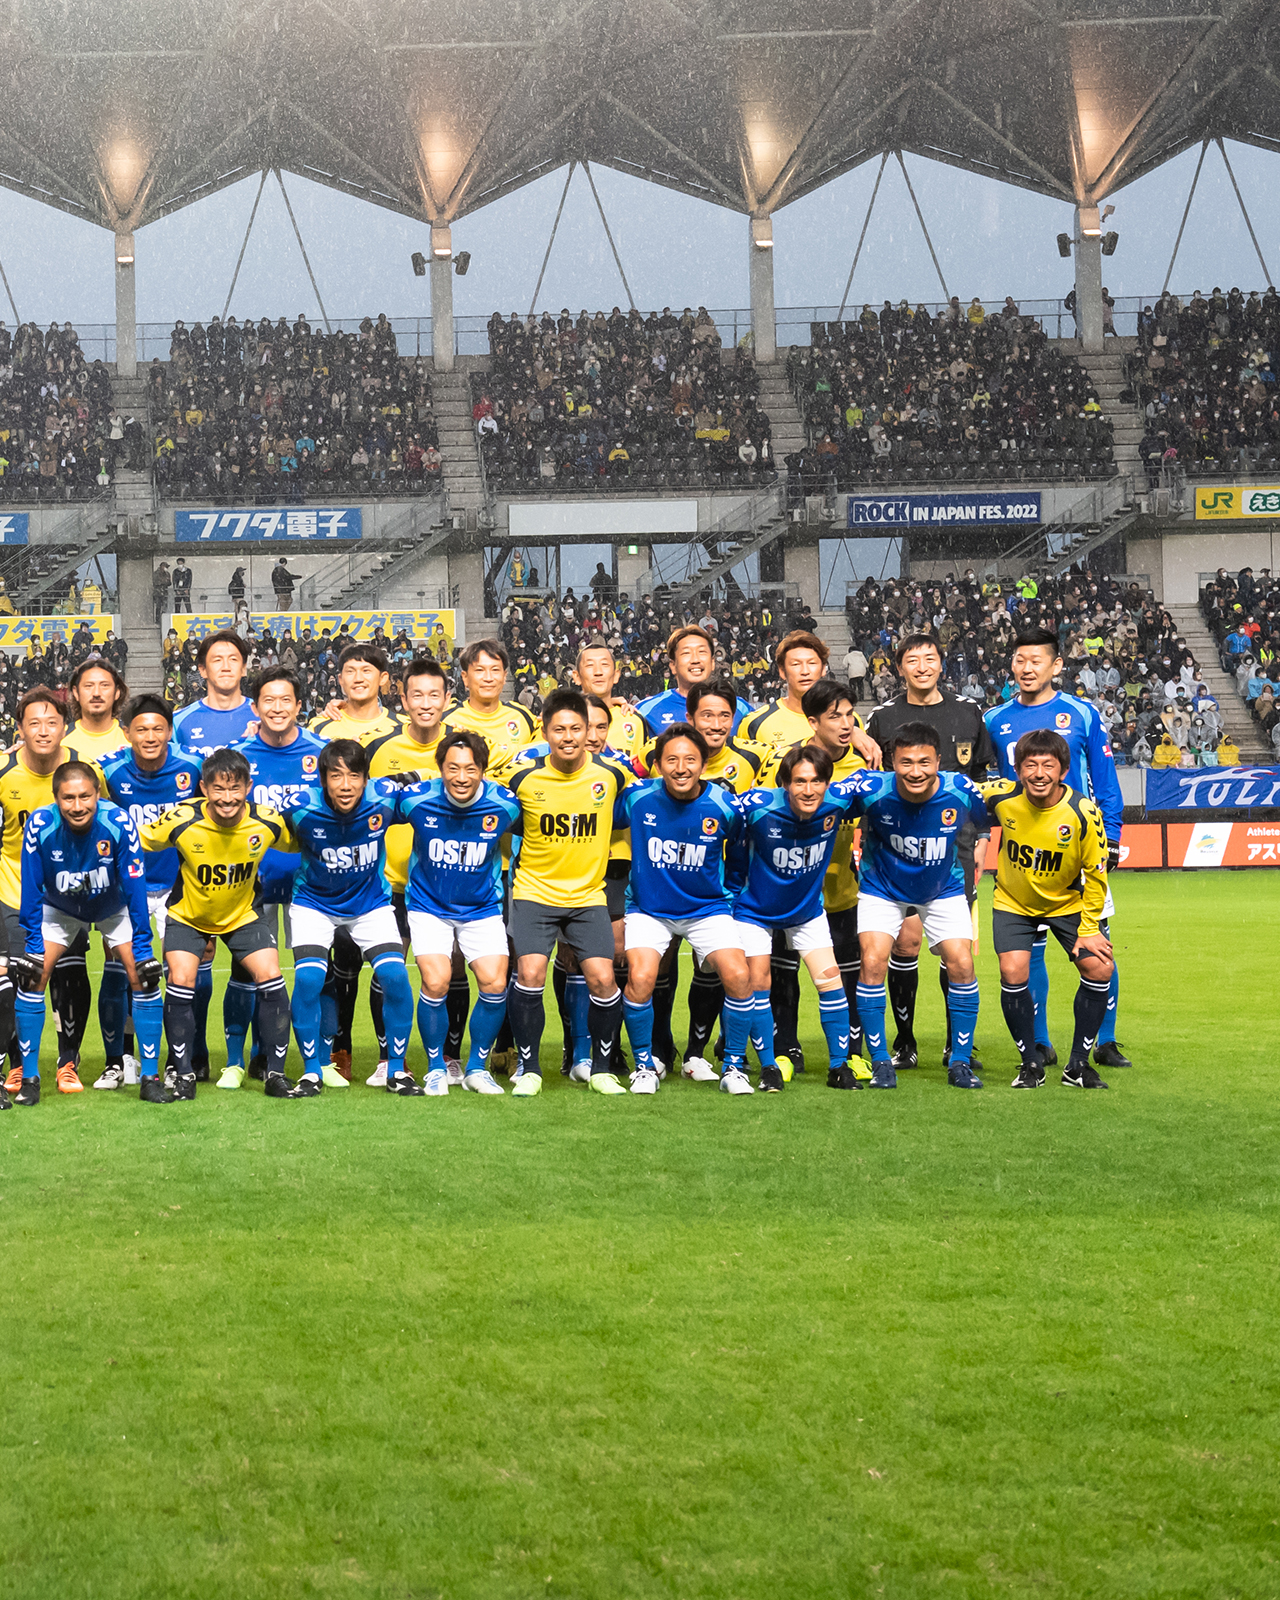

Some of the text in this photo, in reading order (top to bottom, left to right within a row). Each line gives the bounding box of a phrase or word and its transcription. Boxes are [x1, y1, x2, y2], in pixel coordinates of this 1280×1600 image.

[1201, 492, 1234, 509] JR
[853, 502, 1037, 522] ROCK IN JAPAN FES. 2022
[188, 511, 348, 538] フクダ電子
